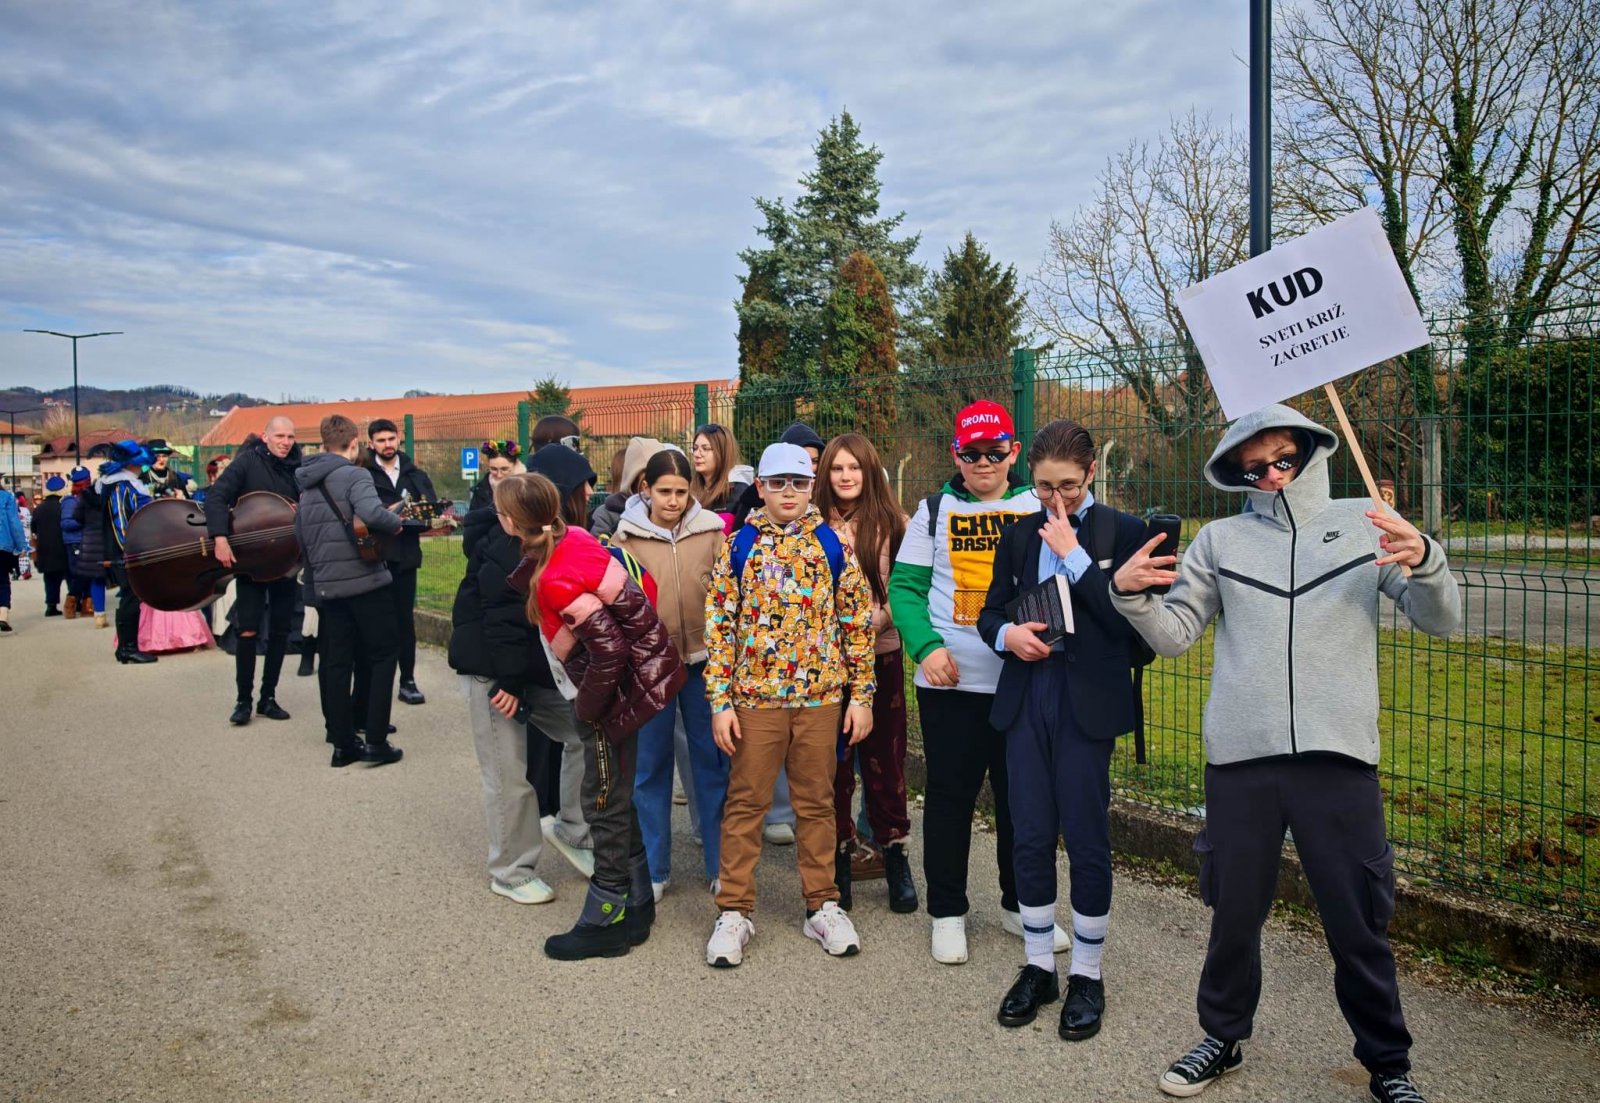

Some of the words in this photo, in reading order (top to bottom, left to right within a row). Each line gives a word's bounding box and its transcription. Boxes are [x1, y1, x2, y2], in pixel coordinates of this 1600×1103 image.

[1246, 267, 1323, 319] KUD
[1259, 322, 1303, 349] SVETI
[1306, 302, 1345, 329] KRIŽ
[1270, 325, 1350, 367] ZAČRETJE
[961, 413, 1001, 428] CROATIA
[466, 451, 474, 465] P
[950, 513, 1020, 536] CHM
[1326, 530, 1340, 538] NIKE
